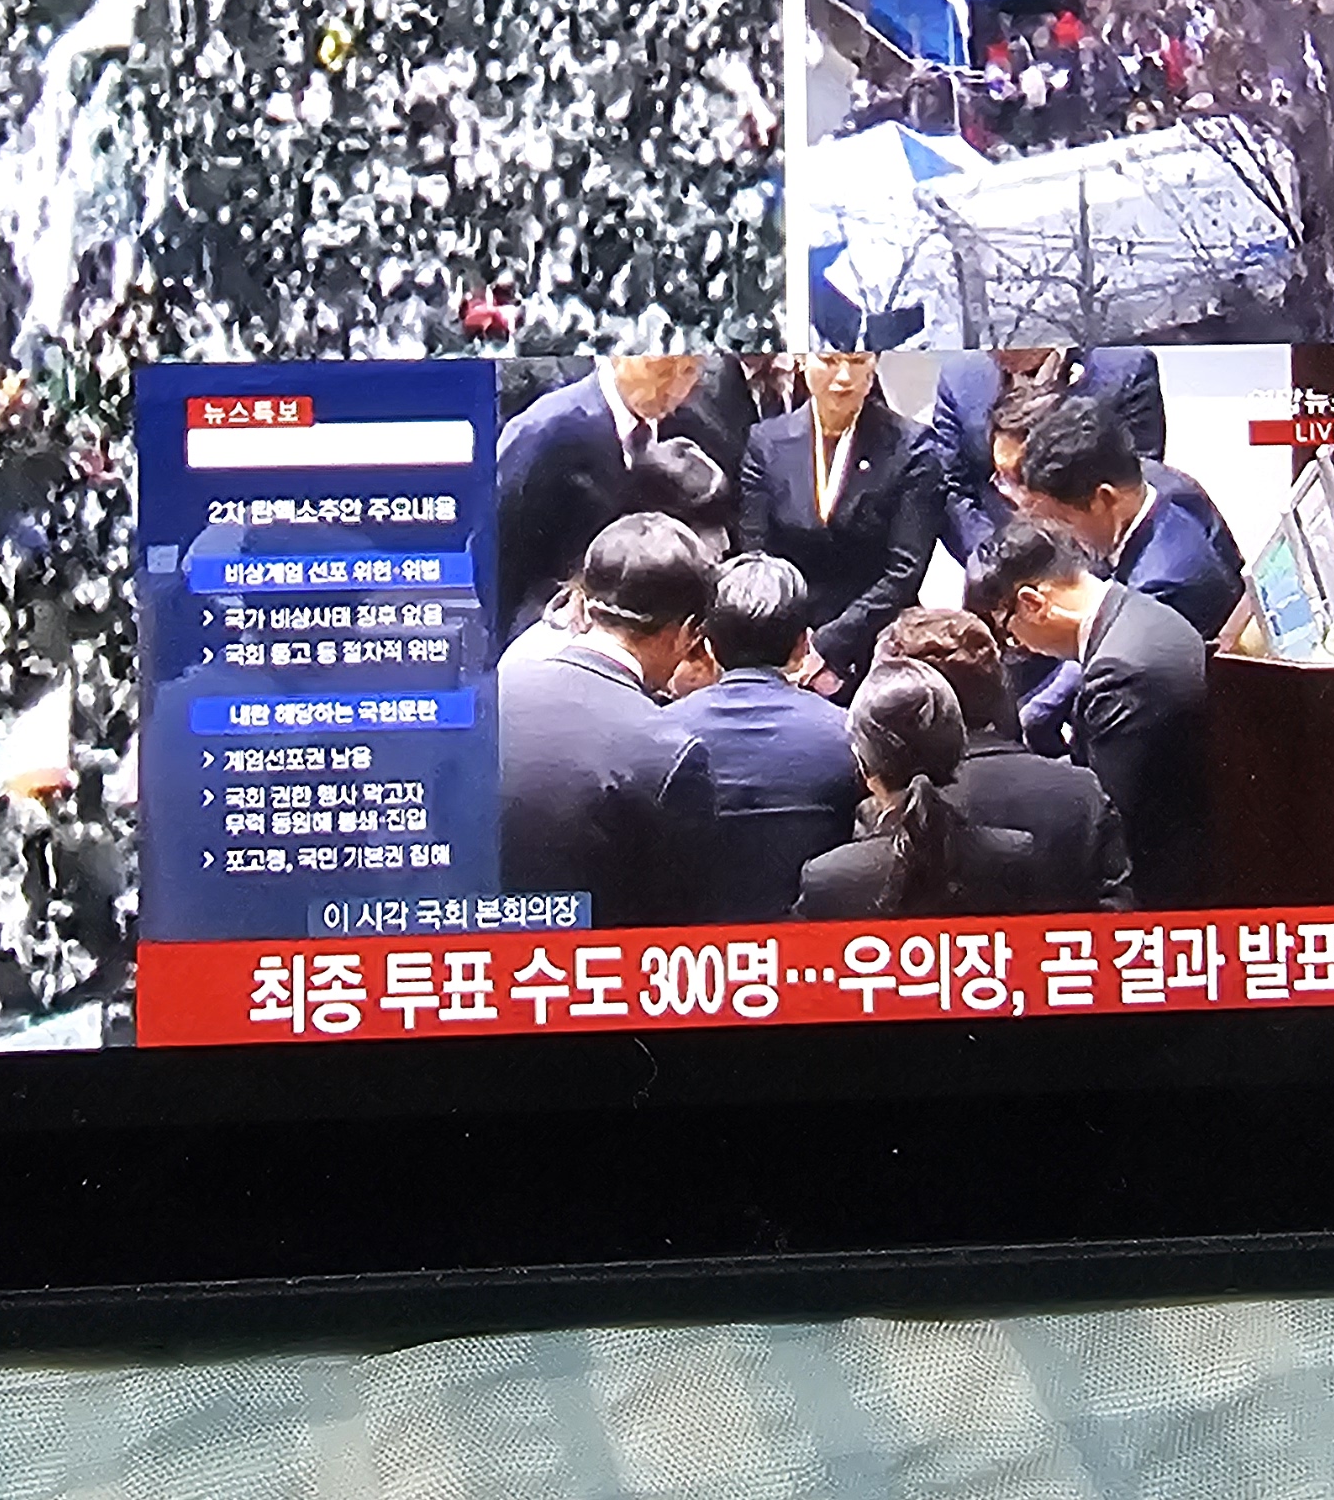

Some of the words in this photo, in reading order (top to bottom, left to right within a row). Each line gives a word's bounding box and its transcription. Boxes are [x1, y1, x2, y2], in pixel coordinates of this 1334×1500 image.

[204, 401, 298, 424] 뉴스특보
[208, 501, 246, 524] 2차
[250, 498, 363, 524] 탄핵소추안
[367, 495, 457, 521] 주요내용
[224, 562, 303, 585] 비상계엄
[308, 561, 348, 583] 선포
[224, 608, 265, 629] 국가
[270, 606, 351, 629] 비상사태
[356, 605, 396, 627] 징후
[401, 603, 443, 626] 없음
[225, 643, 264, 666] 국회
[316, 641, 337, 664] 등
[342, 639, 403, 663] 절차적
[407, 638, 449, 662] 위반
[229, 704, 270, 726] 내란
[274, 702, 353, 725] 해당하는
[357, 699, 438, 723] 국헌문란
[223, 748, 326, 772] 계엄선포권
[330, 747, 372, 769] 남용
[225, 786, 265, 808] 국회
[270, 785, 312, 808] 권한
[316, 783, 358, 806] 행사
[362, 782, 424, 804] 막고자
[225, 812, 265, 835] 무력
[270, 811, 332, 834] 동원해
[297, 847, 338, 870] 국민
[343, 845, 403, 870] 기본권
[408, 843, 451, 867] 침해
[323, 902, 350, 933] 이
[355, 900, 408, 931] 시각
[415, 897, 467, 929] 국회
[474, 895, 579, 928] 본회의장
[249, 952, 367, 1035] 최종
[379, 949, 498, 1030] 투표
[509, 945, 629, 1025] 수도
[1039, 928, 1095, 1007] 곧
[1111, 924, 1225, 1004] 결과
